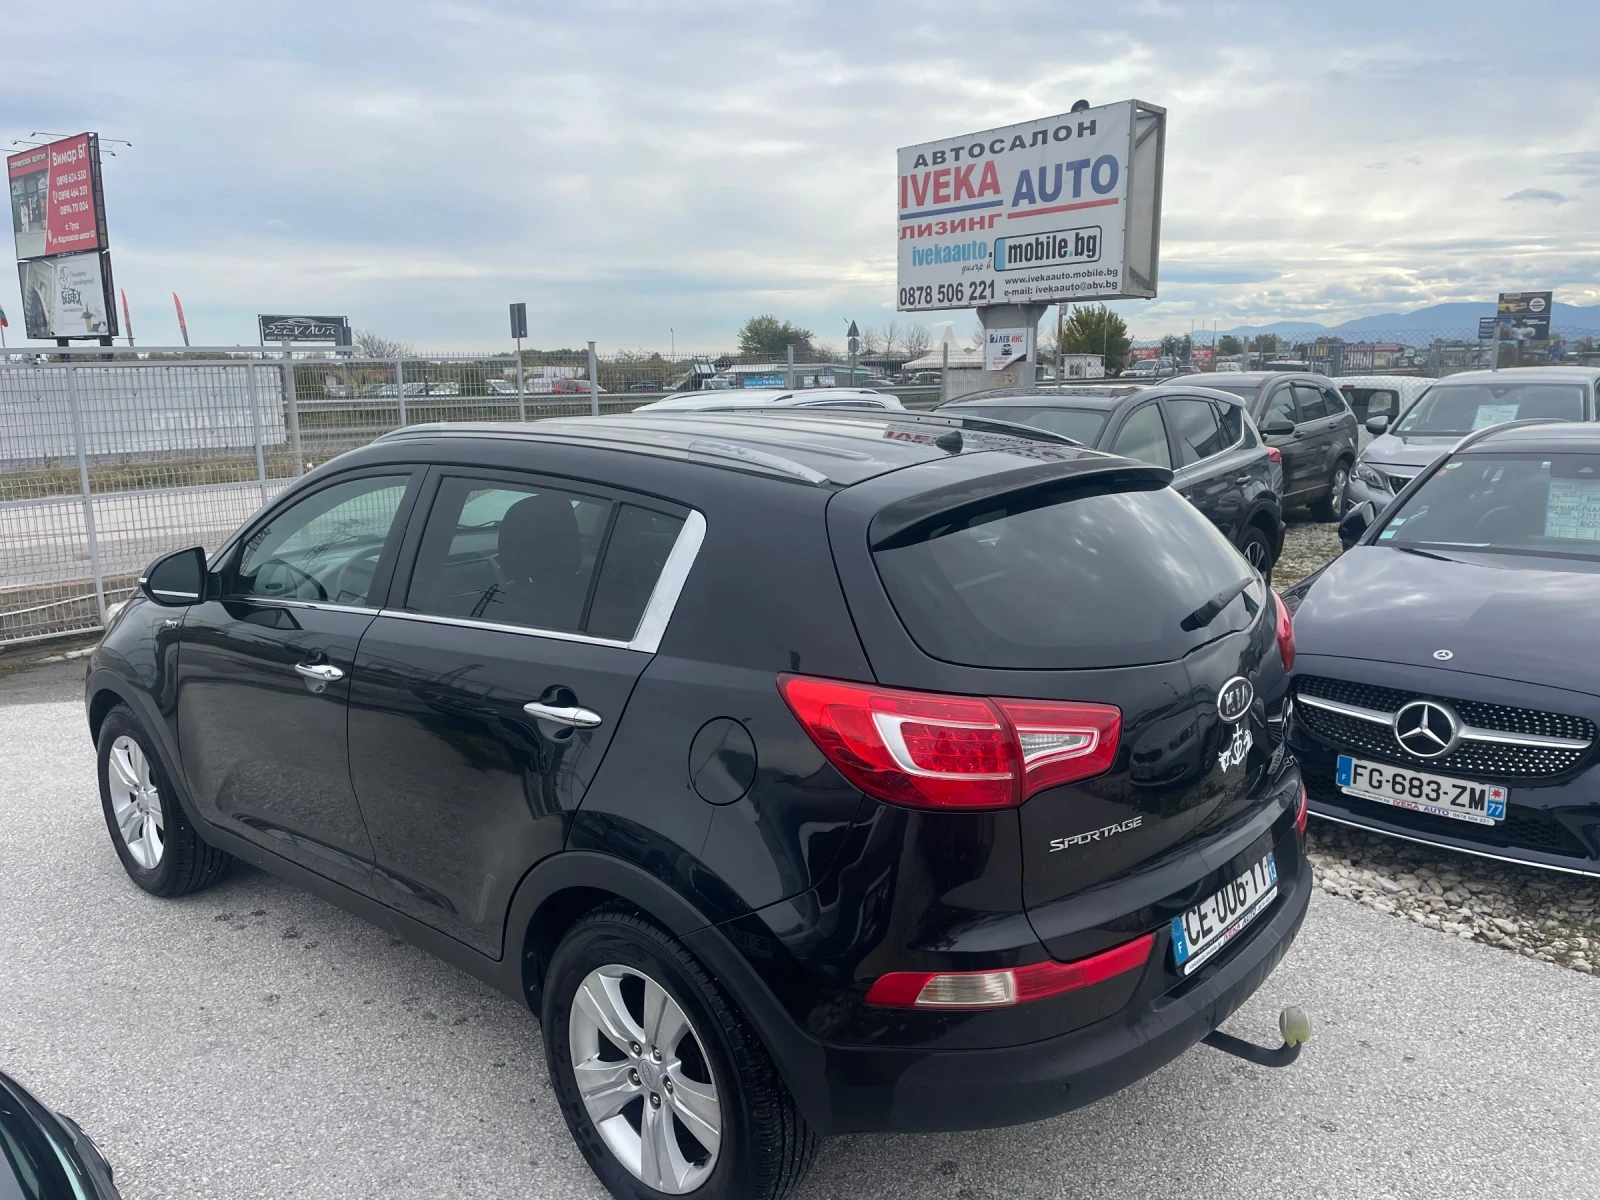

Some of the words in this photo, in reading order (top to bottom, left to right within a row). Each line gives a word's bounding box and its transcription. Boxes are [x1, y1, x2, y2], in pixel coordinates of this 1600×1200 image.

[52, 149, 77, 166] Вимар
[78, 143, 86, 159] БГ
[913, 120, 1096, 169] АВТОСАЛОН
[901, 160, 1001, 209] IVEKA
[1011, 154, 1119, 208] AUTO
[900, 213, 1002, 240] ЛИЗИНГ
[1008, 232, 1097, 264] mobile.bg
[1005, 268, 1118, 285] www.ivekaauto.mobile.bg
[900, 285, 933, 306] 0878
[937, 282, 964, 303] 506
[968, 279, 995, 301] 221
[1004, 286, 1033, 297] e-mail:
[1035, 280, 1118, 294] ivekaauto@abv.bg
[998, 335, 1010, 343] ЛЕВ
[1011, 334, 1023, 343] ИНС
[1224, 685, 1249, 715] KIA
[1341, 773, 1347, 781] F
[1352, 763, 1487, 812] FG-683-ZM
[1393, 800, 1420, 810] IVEKA
[1423, 806, 1450, 816] AUTO
[1488, 803, 1503, 815] 77
[1049, 816, 1143, 853] SPORTAGE
[1269, 862, 1277, 880] 13
[1242, 907, 1257, 926] AUTO
[1177, 940, 1183, 954] F
